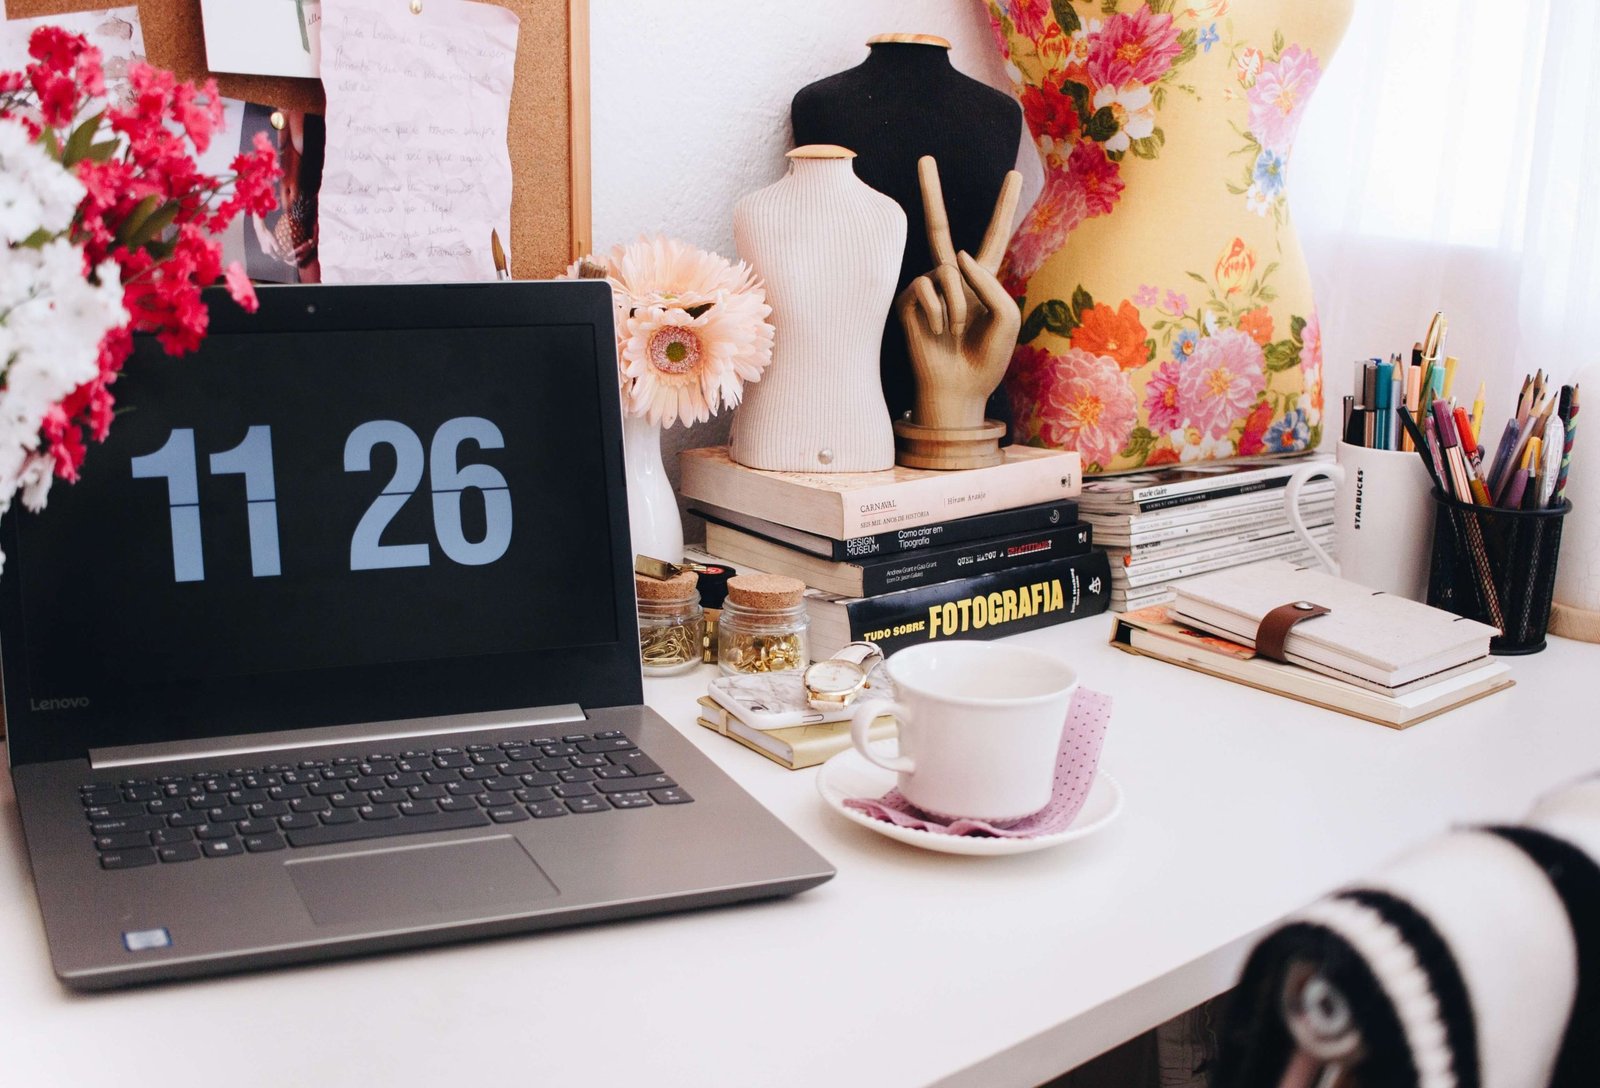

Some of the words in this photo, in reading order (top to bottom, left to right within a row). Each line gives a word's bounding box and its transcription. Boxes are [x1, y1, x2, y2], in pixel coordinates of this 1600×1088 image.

[131, 424, 282, 582] 11
[343, 416, 513, 571] 26
[860, 500, 897, 513] CARNAVAL
[947, 495, 965, 505] Hiram
[1354, 469, 1364, 530] STARBUCKS
[883, 517, 897, 525] ANOS
[898, 530, 918, 540] Como
[918, 527, 932, 536] criar
[932, 526, 943, 534] em
[847, 537, 875, 548] DESIGN
[847, 544, 879, 556] MUSEUM
[898, 537, 930, 549] Tipografia
[957, 554, 974, 566] QUEM
[976, 551, 997, 562] MATOU
[864, 628, 891, 642] TUDO
[892, 620, 925, 636] SOBRE
[929, 579, 1064, 639] FOTOGRAFIA
[30, 697, 90, 712] Lenovo
